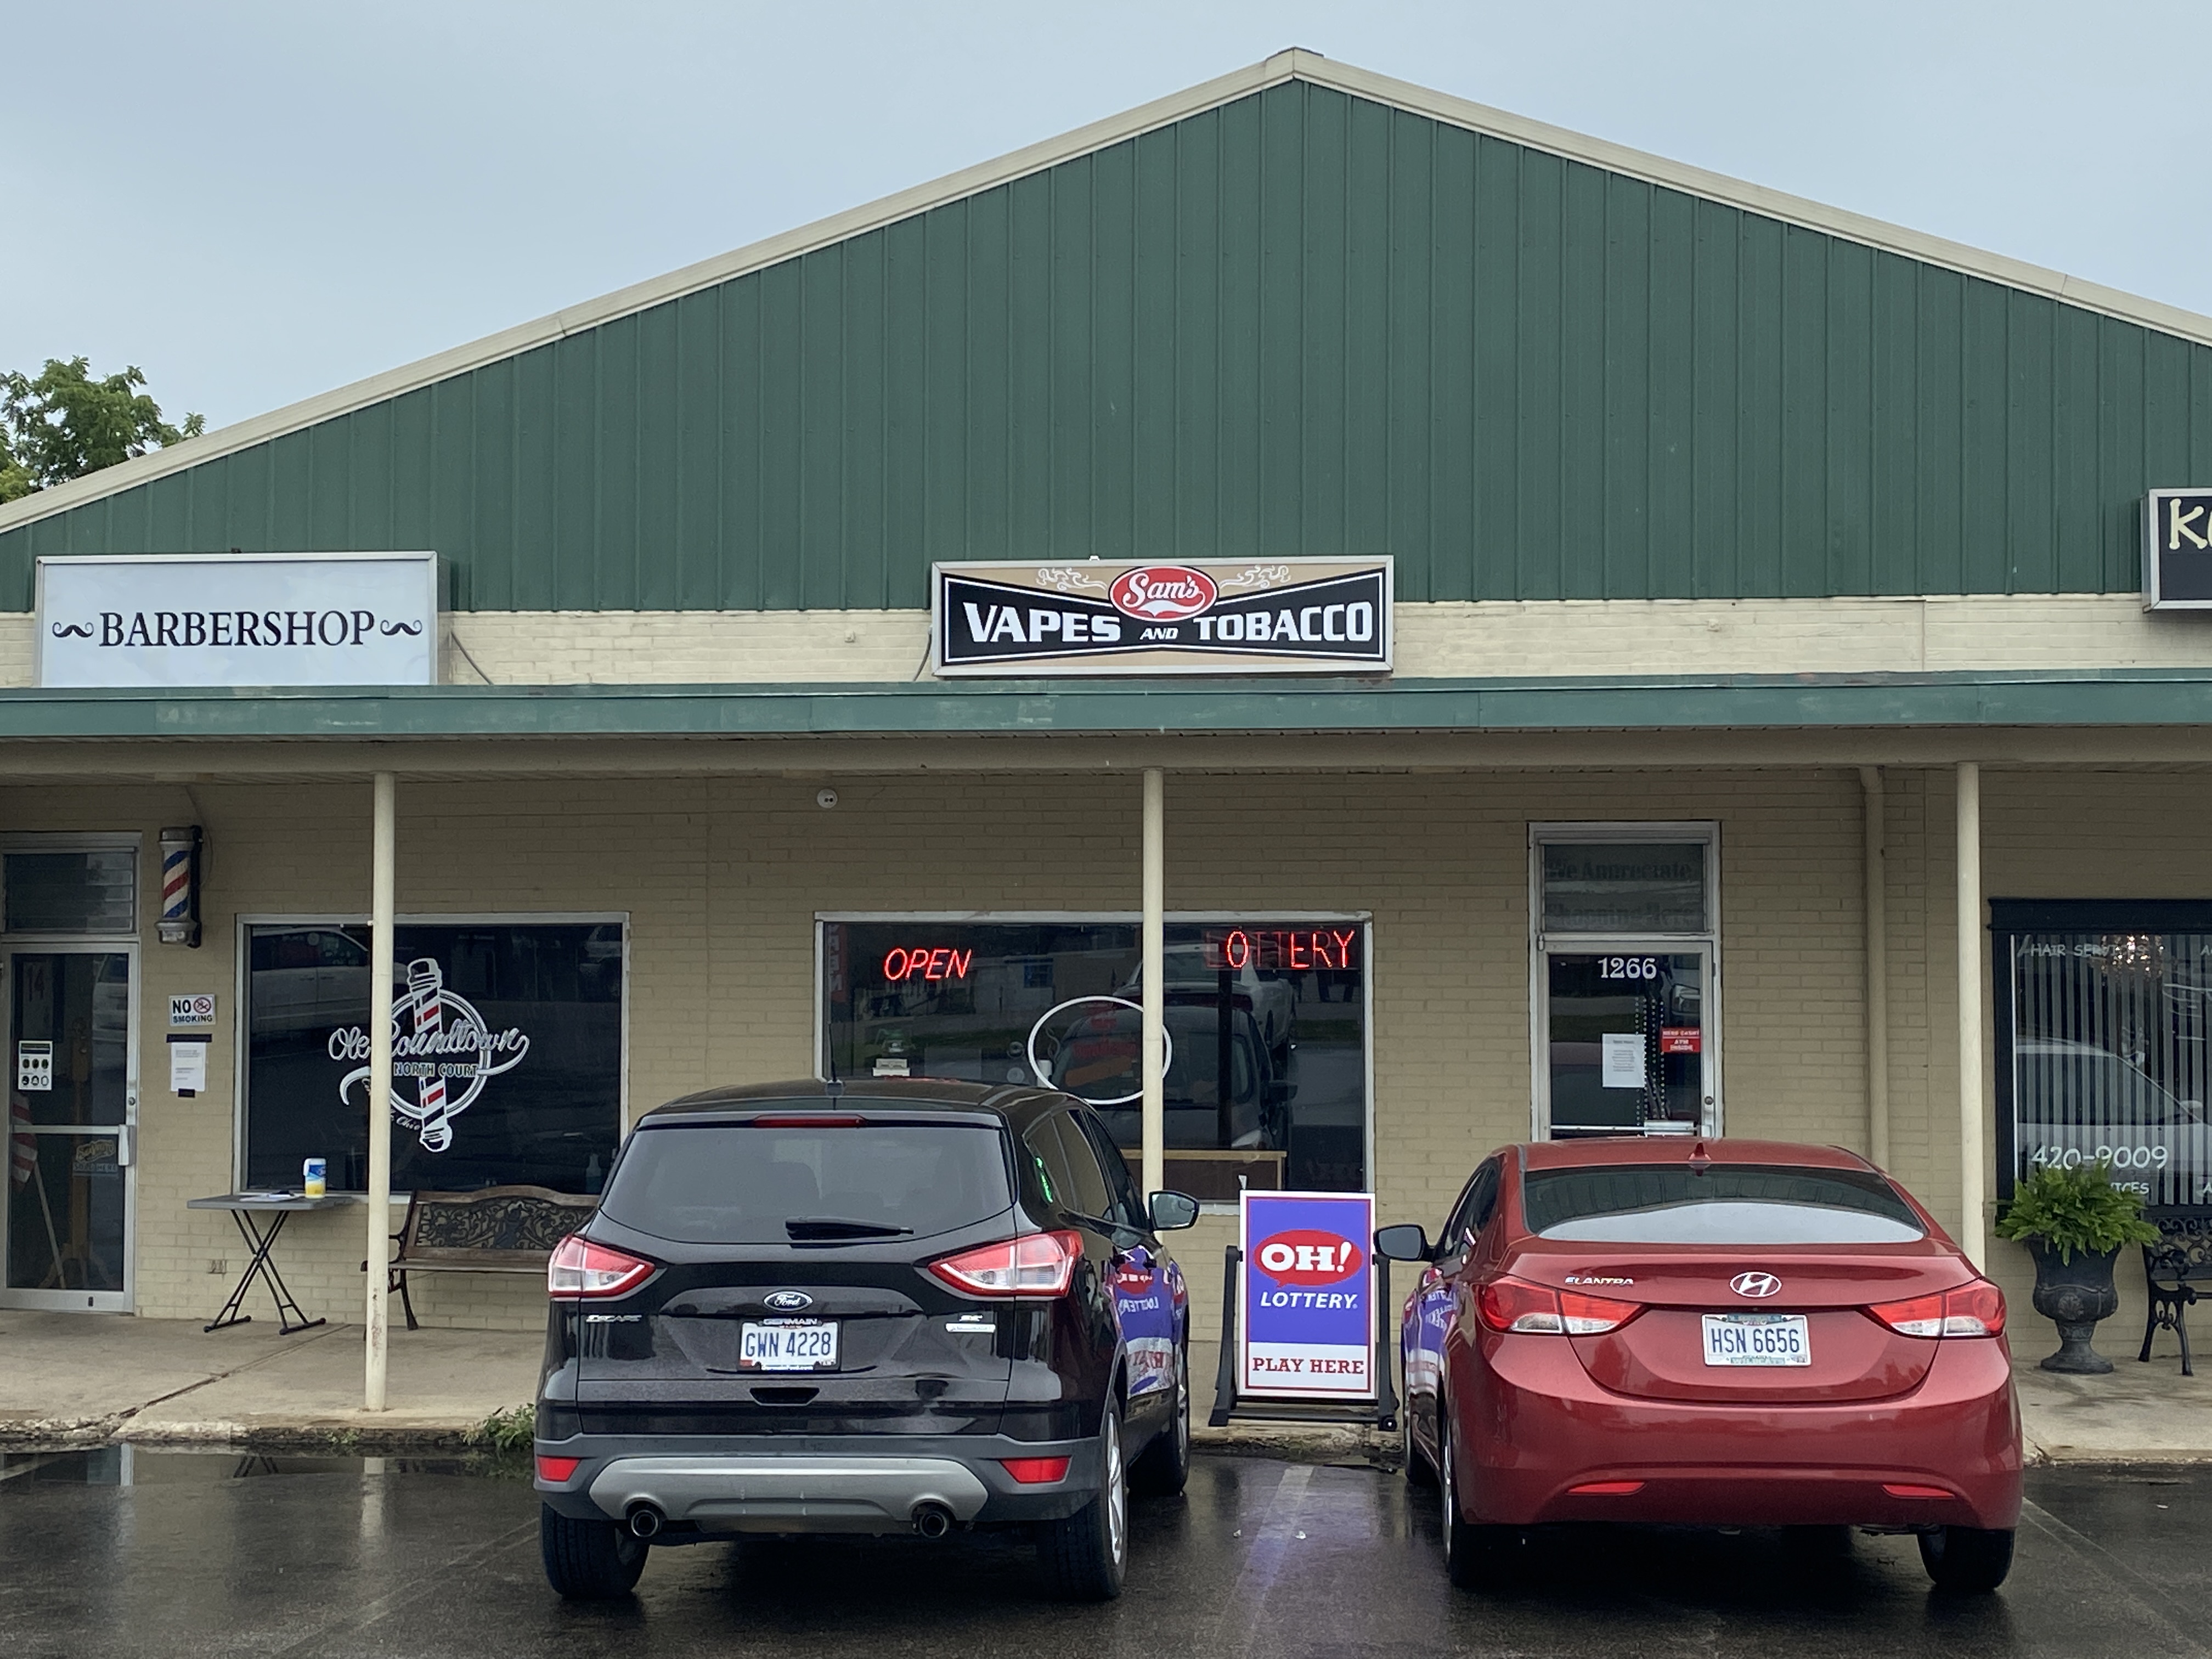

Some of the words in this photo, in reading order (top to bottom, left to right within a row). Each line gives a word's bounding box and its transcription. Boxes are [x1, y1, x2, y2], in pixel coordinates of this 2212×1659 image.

[2169, 498, 2212, 550] K
[1122, 573, 1201, 608] Sam's
[99, 610, 375, 647] BARBERSHOP
[962, 602, 1121, 643] VAPES
[1139, 628, 1178, 640] AND
[1193, 601, 1373, 642] TOBACCO
[2030, 942, 2066, 957] HAIR
[884, 948, 972, 980] OPEN
[1597, 957, 1657, 979] 1266
[173, 1000, 191, 1014] NO
[173, 1015, 213, 1024] SMOKING
[329, 1026, 371, 1060] Ole
[393, 1062, 436, 1077] NORTH
[439, 1063, 478, 1077] COURT
[2030, 1145, 2168, 1170] 420-9009
[1261, 1241, 1353, 1272] OH!
[1565, 1276, 1634, 1286] ELANTRA
[774, 1294, 802, 1306] Ford
[1260, 1291, 1355, 1309] LOTTERY
[746, 1331, 780, 1357] GWN
[786, 1331, 831, 1357] 4228
[1711, 1328, 1747, 1353] HSN
[1753, 1328, 1800, 1353] 6656
[1252, 1358, 1305, 1372] PLAY
[1310, 1359, 1364, 1374] HERE
